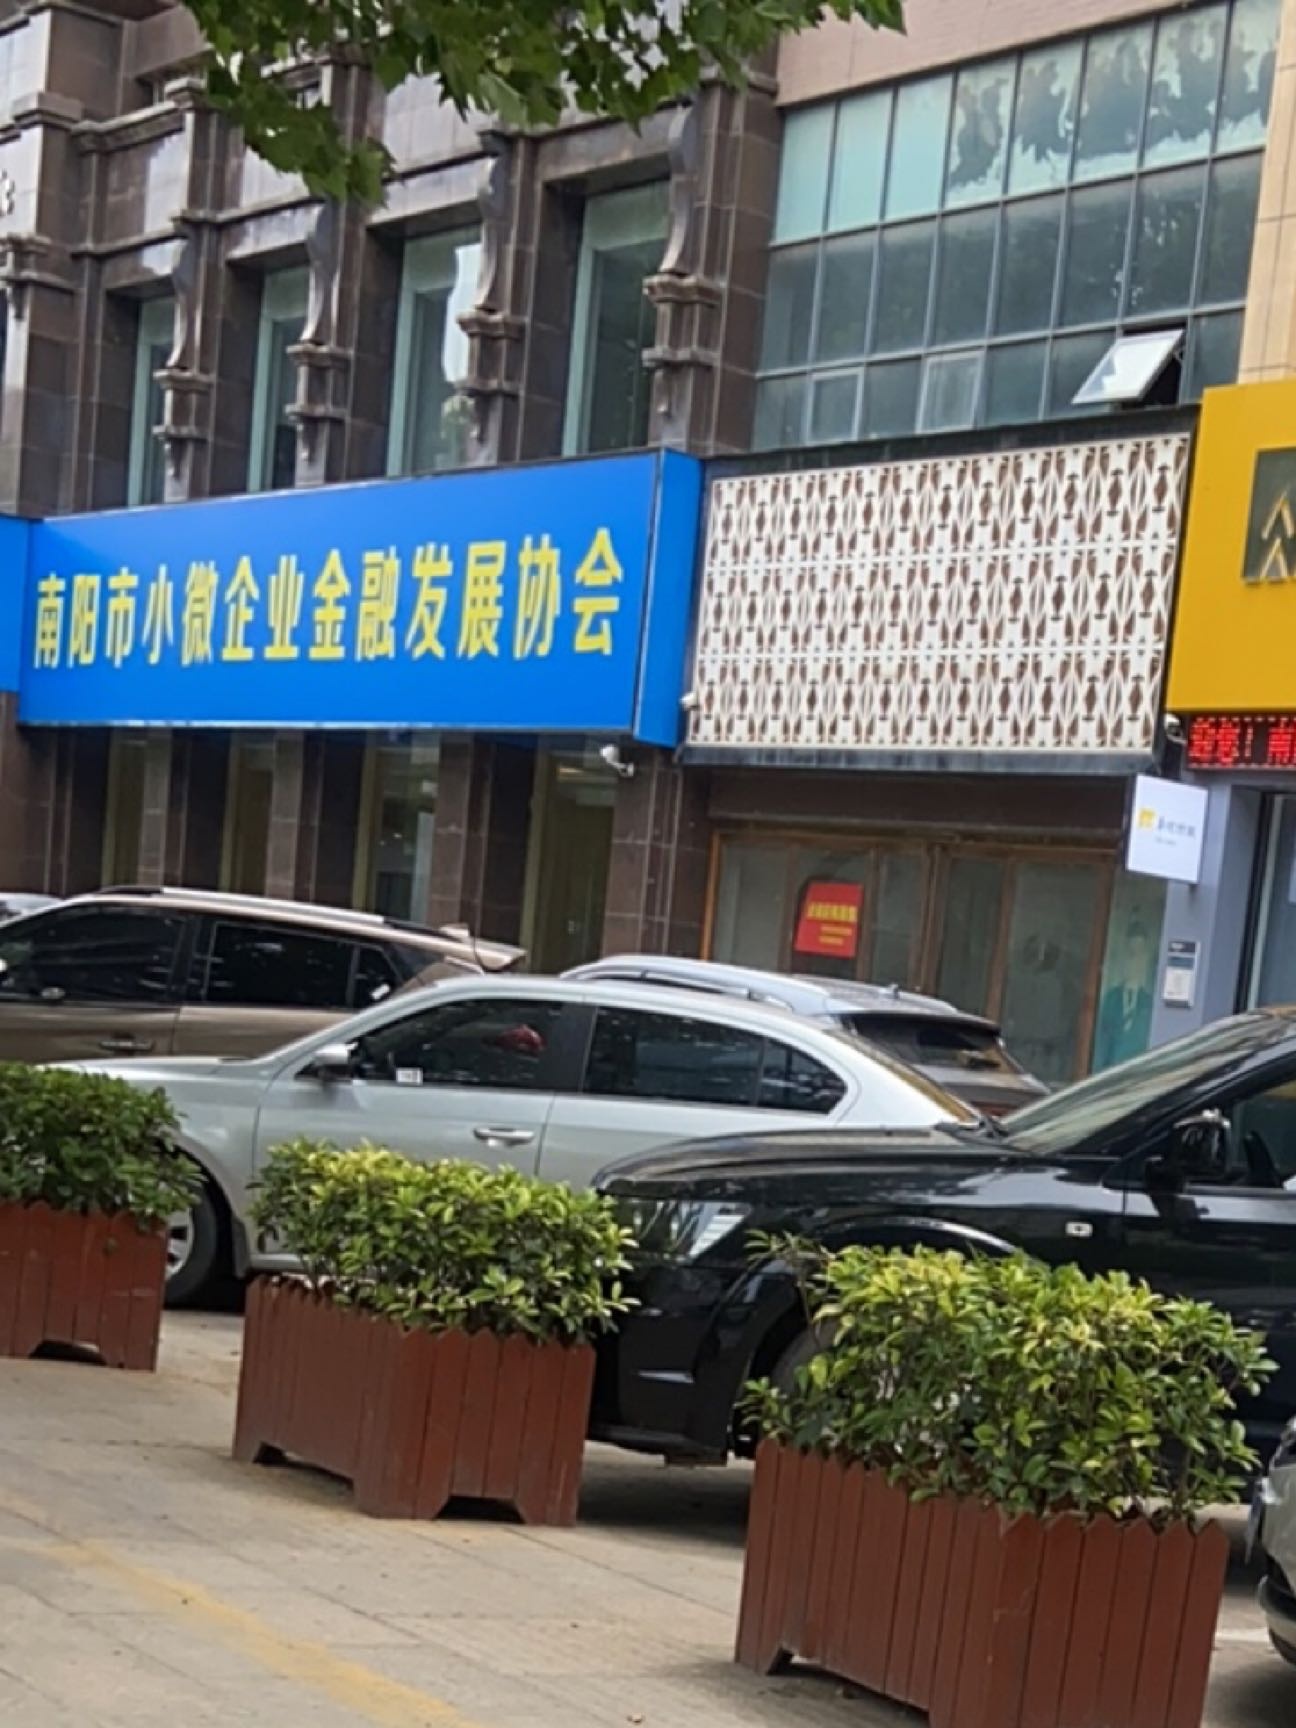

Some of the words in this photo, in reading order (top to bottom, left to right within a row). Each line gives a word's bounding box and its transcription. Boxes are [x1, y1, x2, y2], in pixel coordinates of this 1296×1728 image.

[34, 526, 624, 669] 南阳市小微企业金融发展协会
